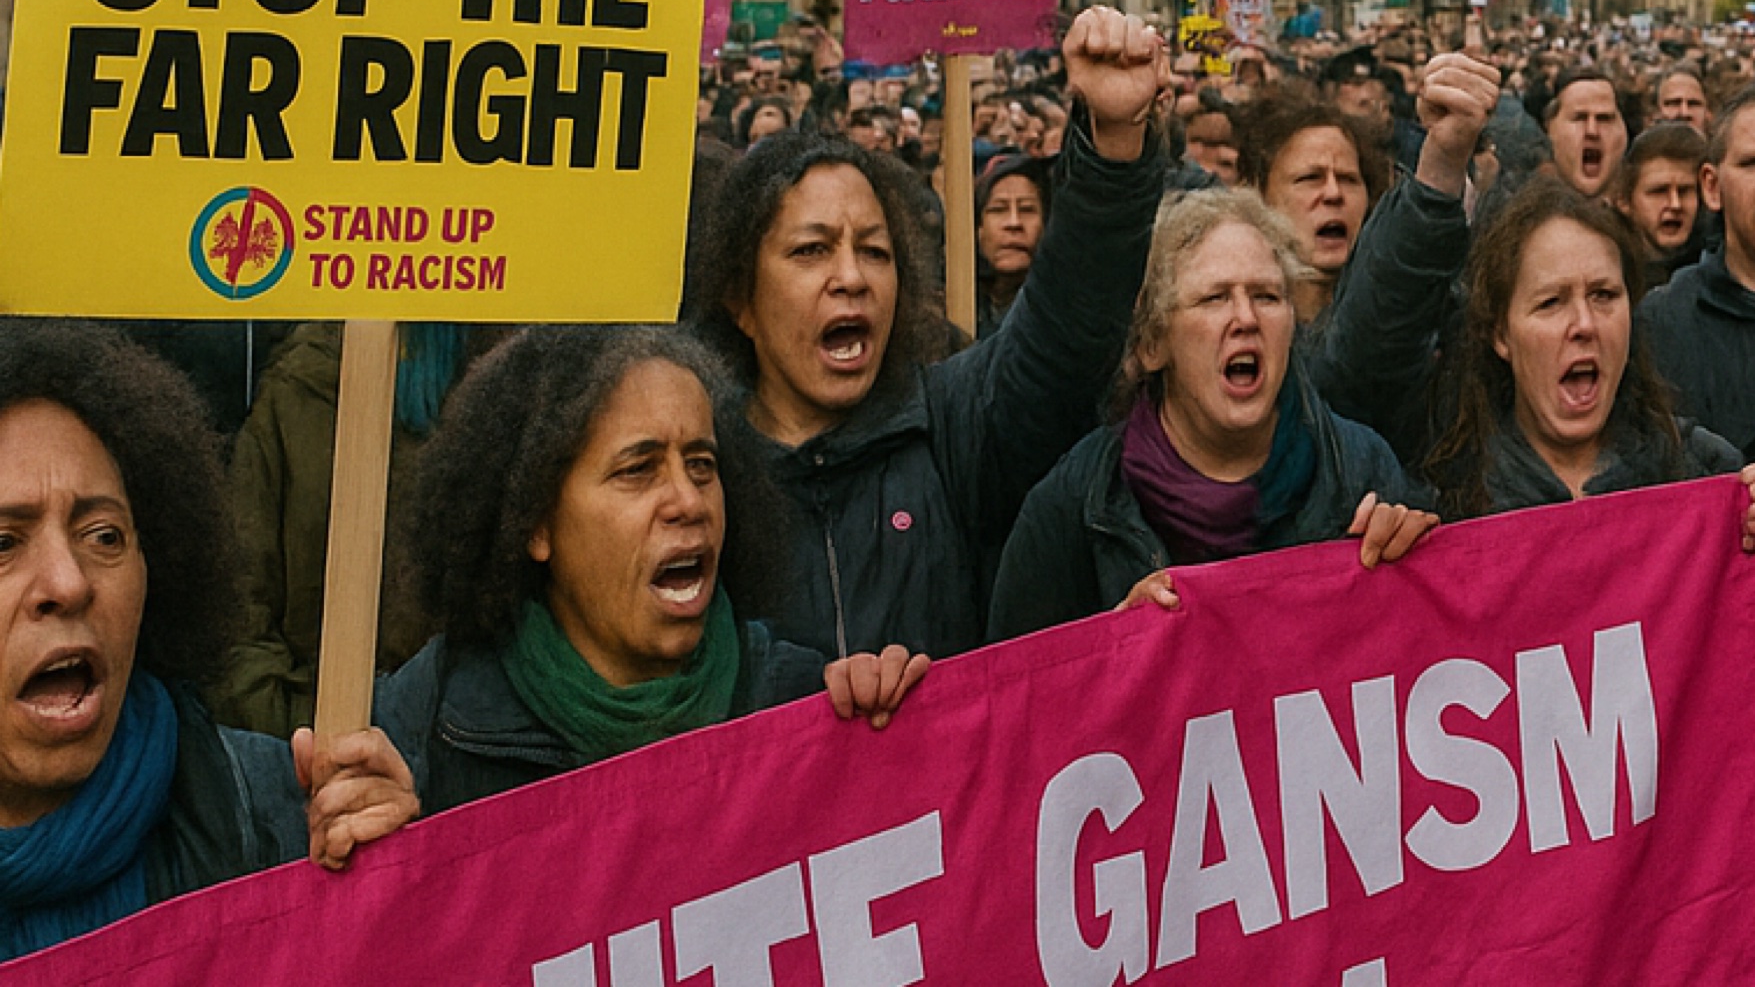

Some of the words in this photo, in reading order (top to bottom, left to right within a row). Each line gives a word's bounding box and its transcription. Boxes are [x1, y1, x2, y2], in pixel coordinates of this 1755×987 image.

[60, 27, 301, 161] FAR
[332, 36, 667, 170] RIGHT
[303, 204, 430, 242] STAND
[441, 207, 495, 244] UP
[309, 253, 355, 290] TO
[366, 254, 507, 291] RACISM
[1036, 621, 1658, 987] GANSM
